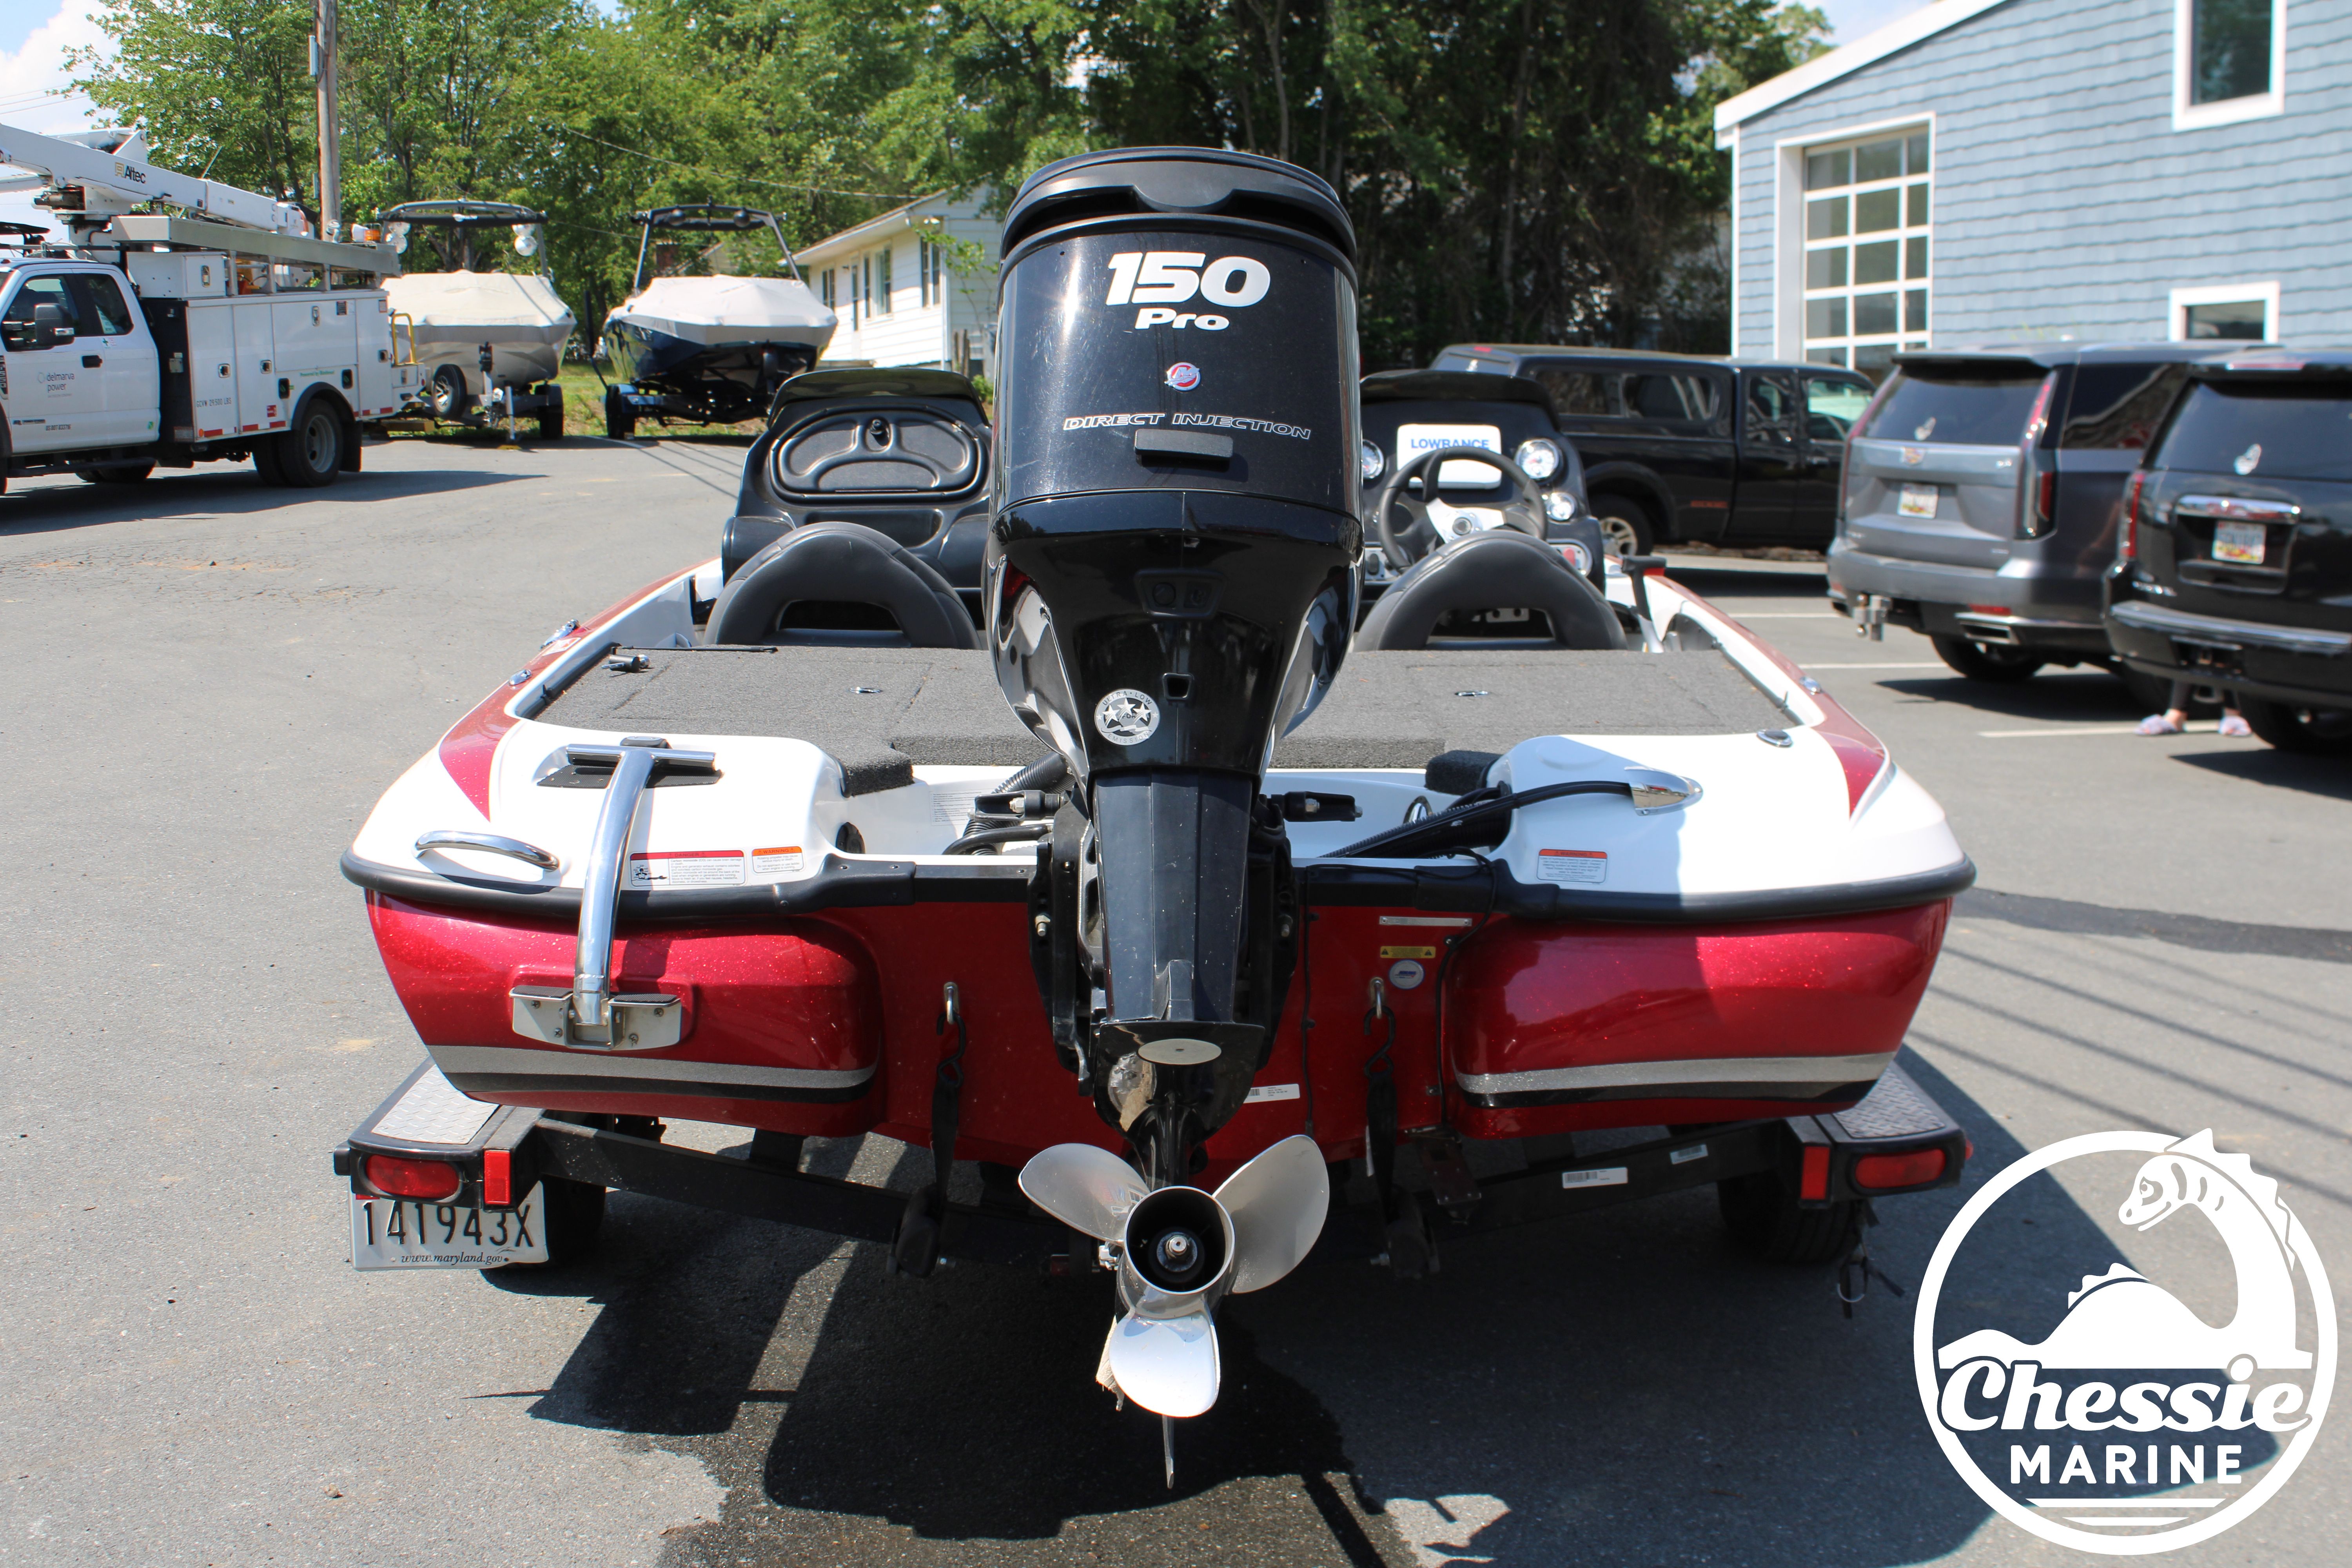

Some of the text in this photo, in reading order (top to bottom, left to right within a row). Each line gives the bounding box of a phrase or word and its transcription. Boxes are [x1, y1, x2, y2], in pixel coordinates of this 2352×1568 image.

[124, 165, 145, 183] Altec
[1106, 251, 1270, 307] 150
[1135, 307, 1229, 330] Pro
[47, 372, 75, 381] delmarva
[47, 383, 67, 393] power
[1063, 412, 1311, 439] DIRECT INJECTION
[1411, 438, 1490, 450] LOWRANCE
[1103, 691, 1152, 706] ULTRA LOW
[1108, 732, 1150, 744] EMISSION
[363, 1202, 534, 1247] 141943X
[401, 1251, 503, 1265] www.maryland.gov
